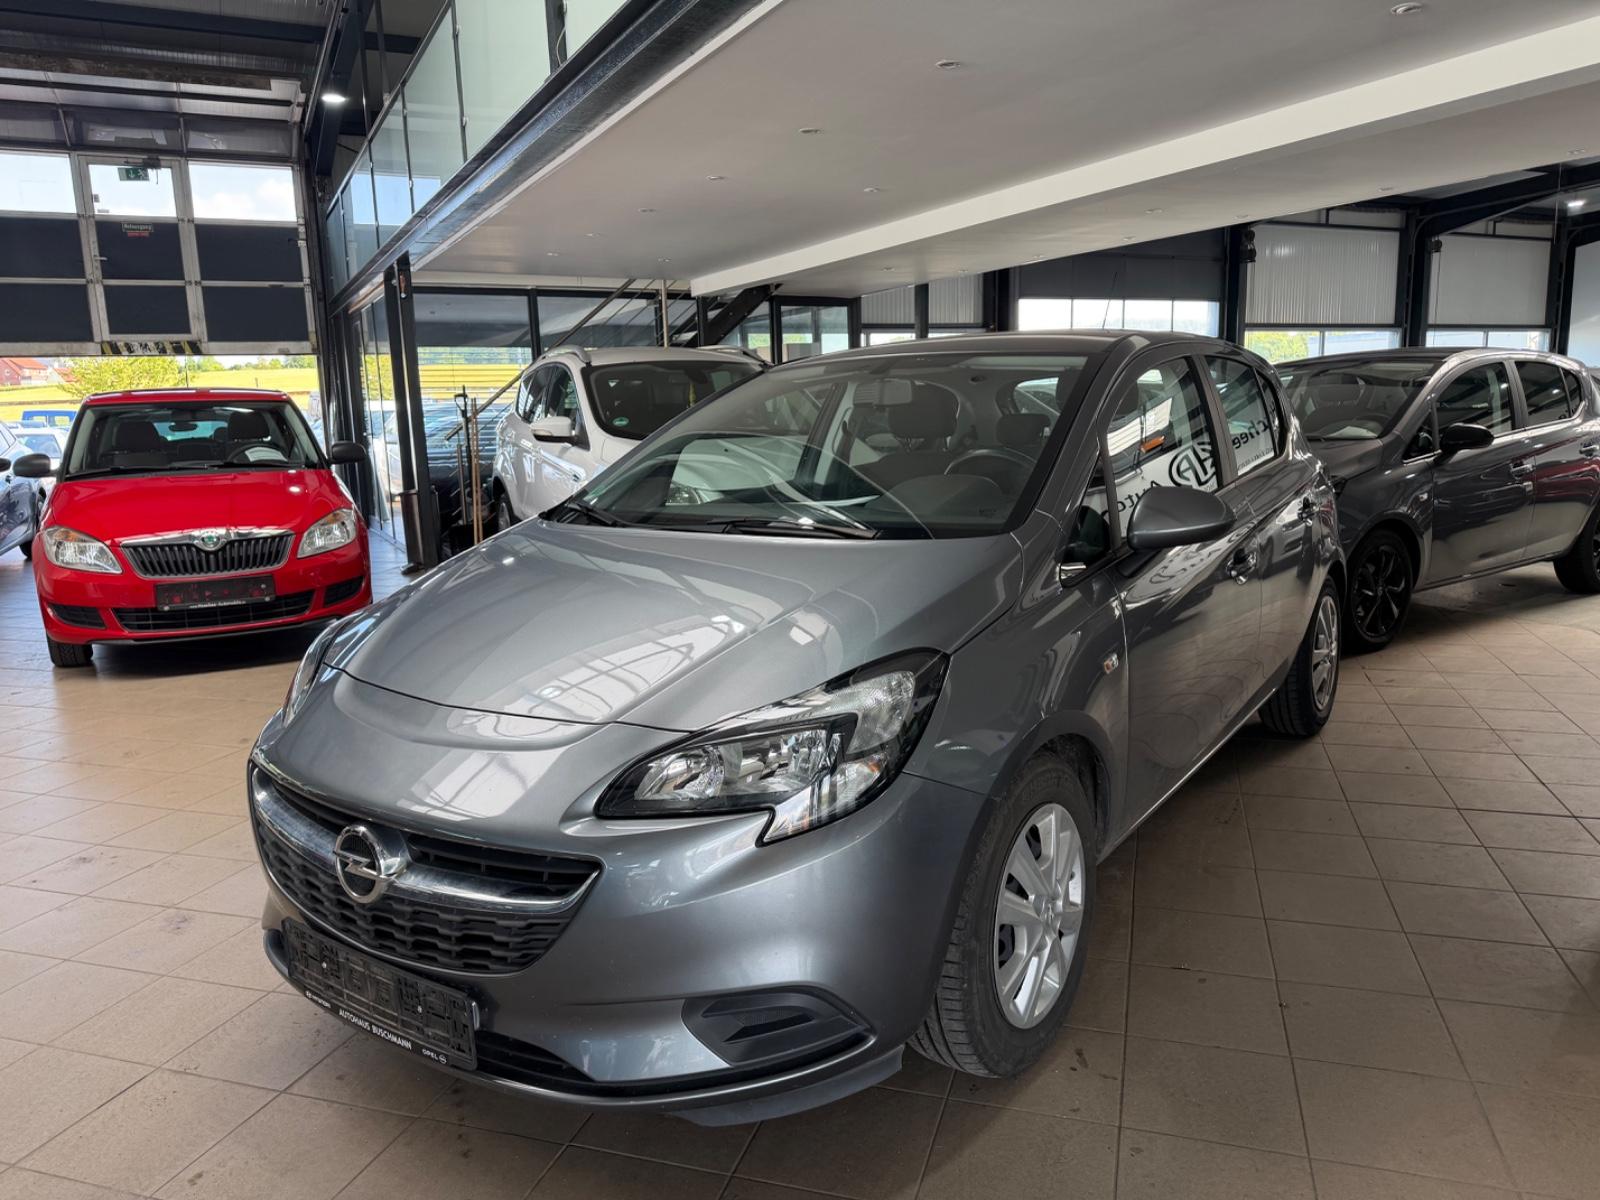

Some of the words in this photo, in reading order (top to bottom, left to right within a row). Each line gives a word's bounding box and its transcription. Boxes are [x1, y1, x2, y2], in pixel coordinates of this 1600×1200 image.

[339, 1009, 371, 1031] AUTOHAUS
[372, 1024, 411, 1049] BUSCHMANN
[422, 1048, 438, 1060] OPEL
